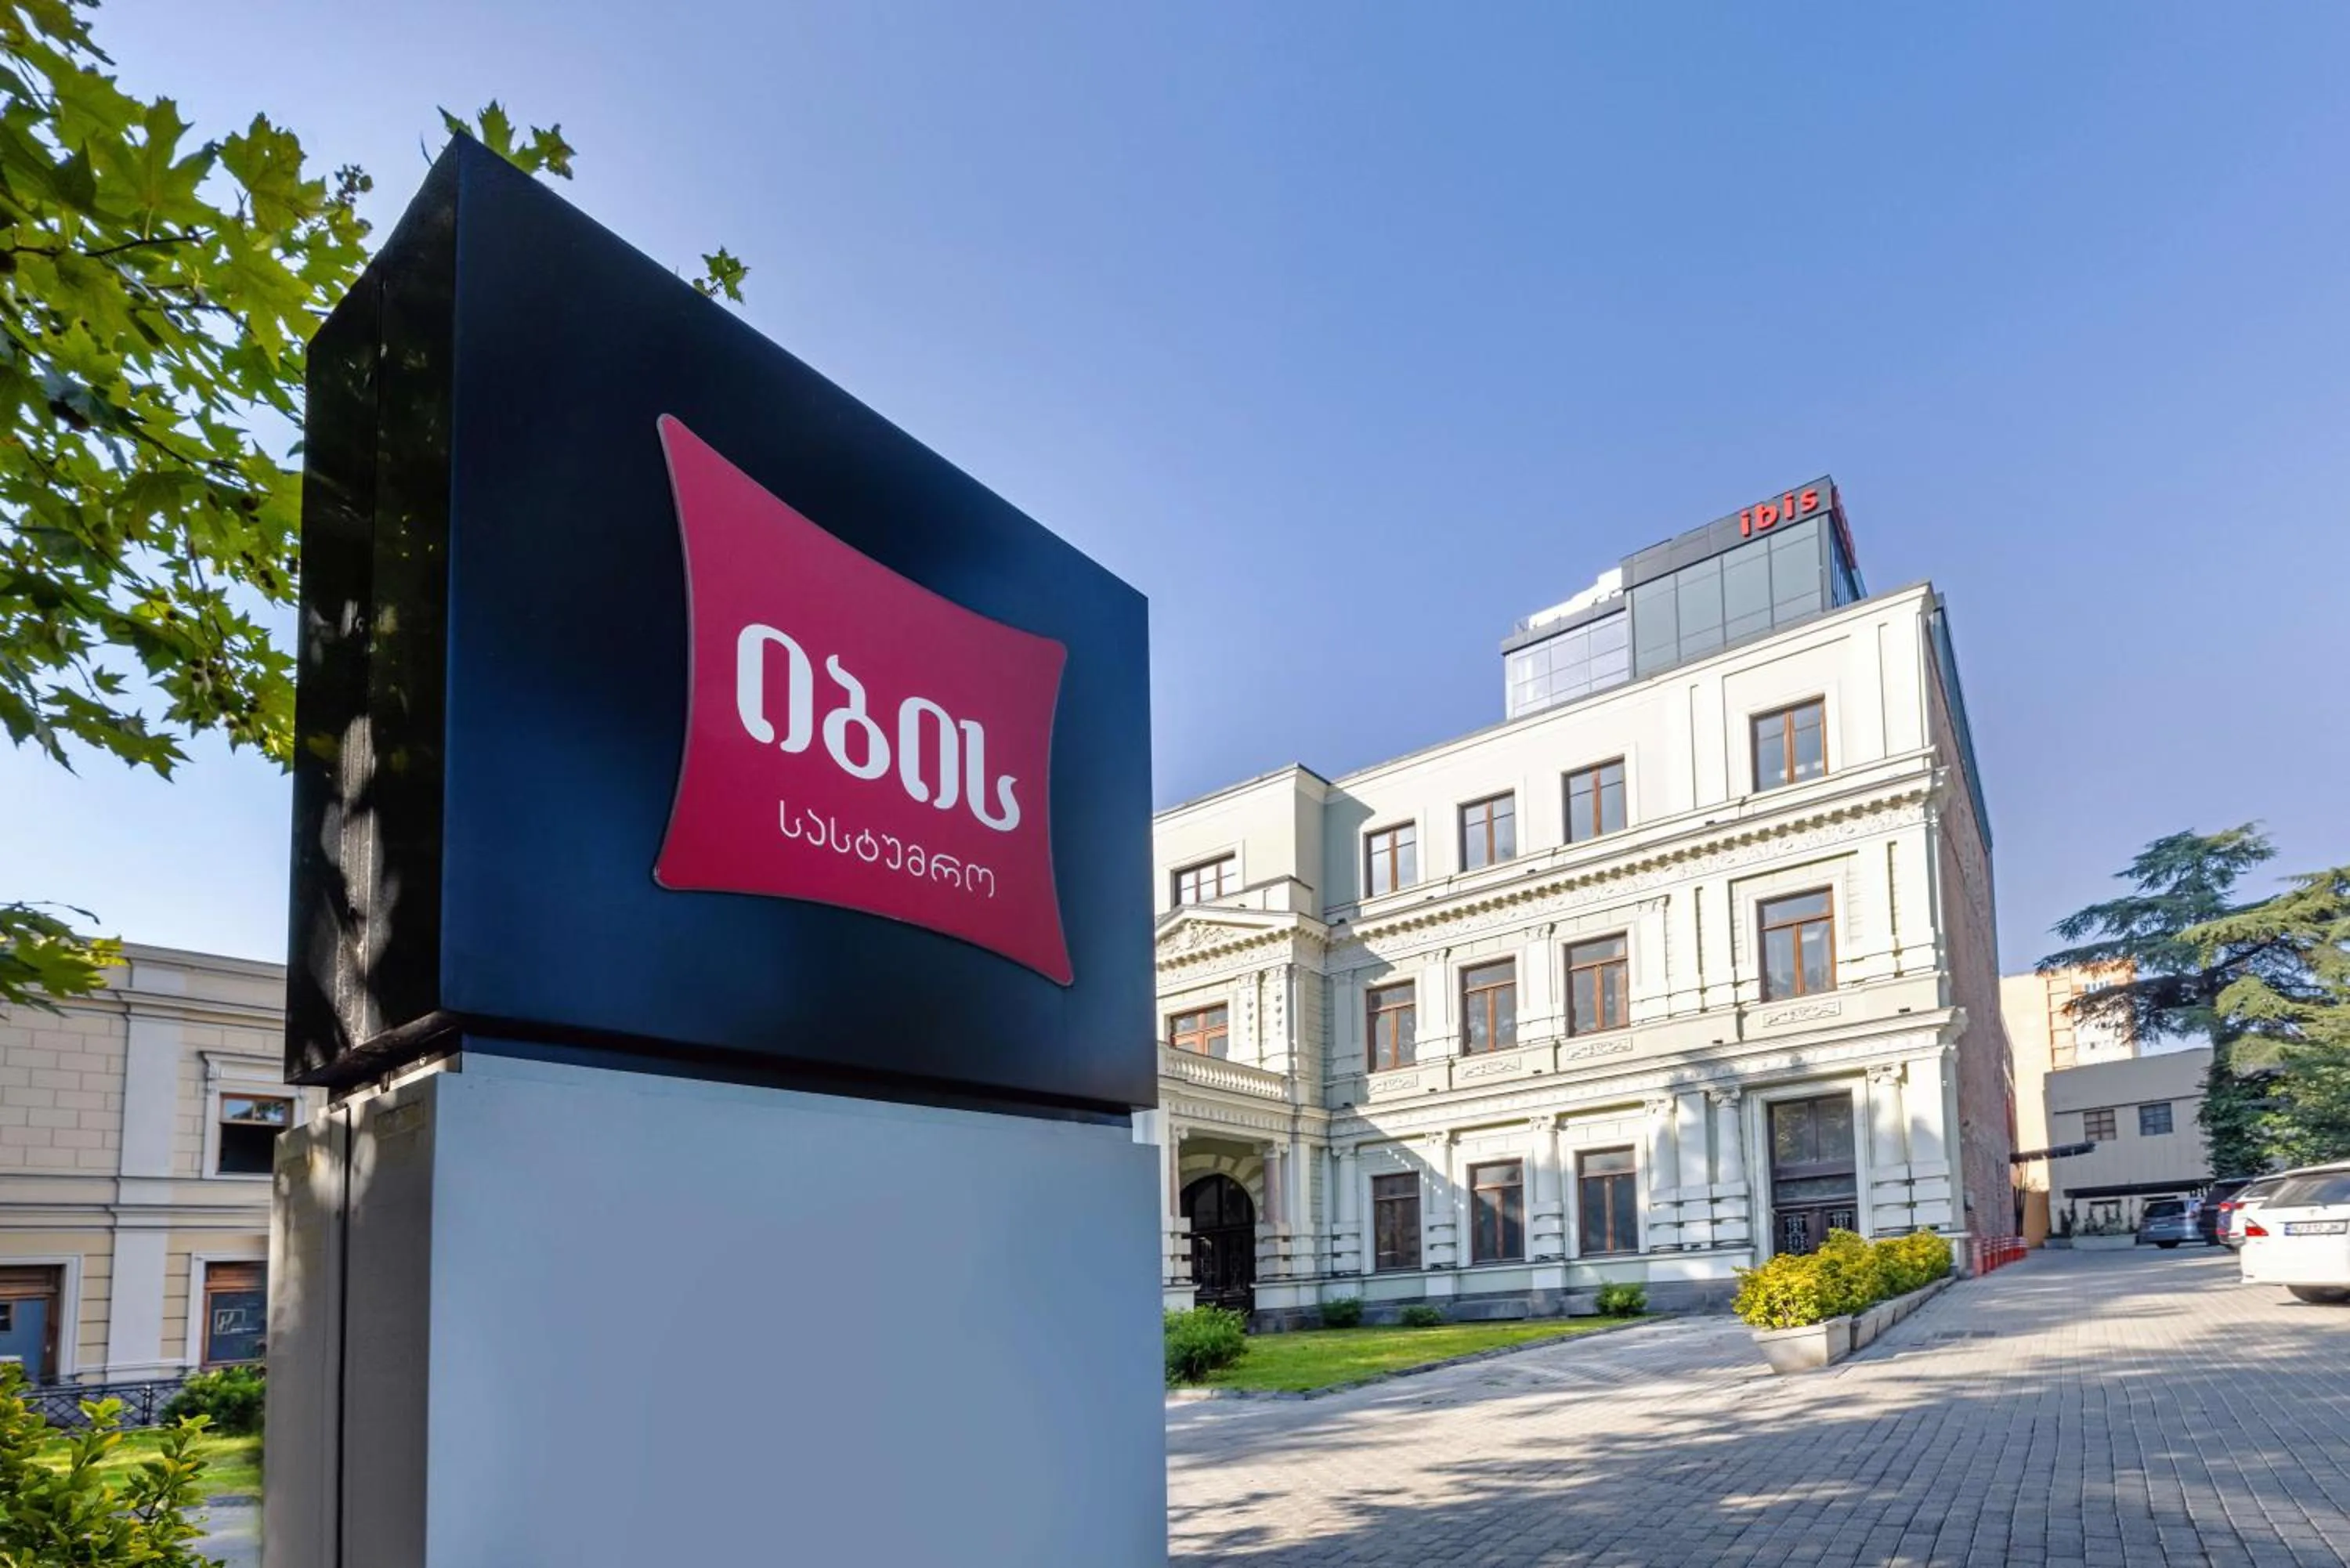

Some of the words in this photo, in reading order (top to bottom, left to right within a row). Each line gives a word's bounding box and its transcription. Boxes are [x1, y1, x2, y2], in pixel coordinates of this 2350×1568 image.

[1740, 490, 1818, 537] ibis
[736, 623, 1021, 832] იბის
[779, 800, 994, 898] სასტუმრო
